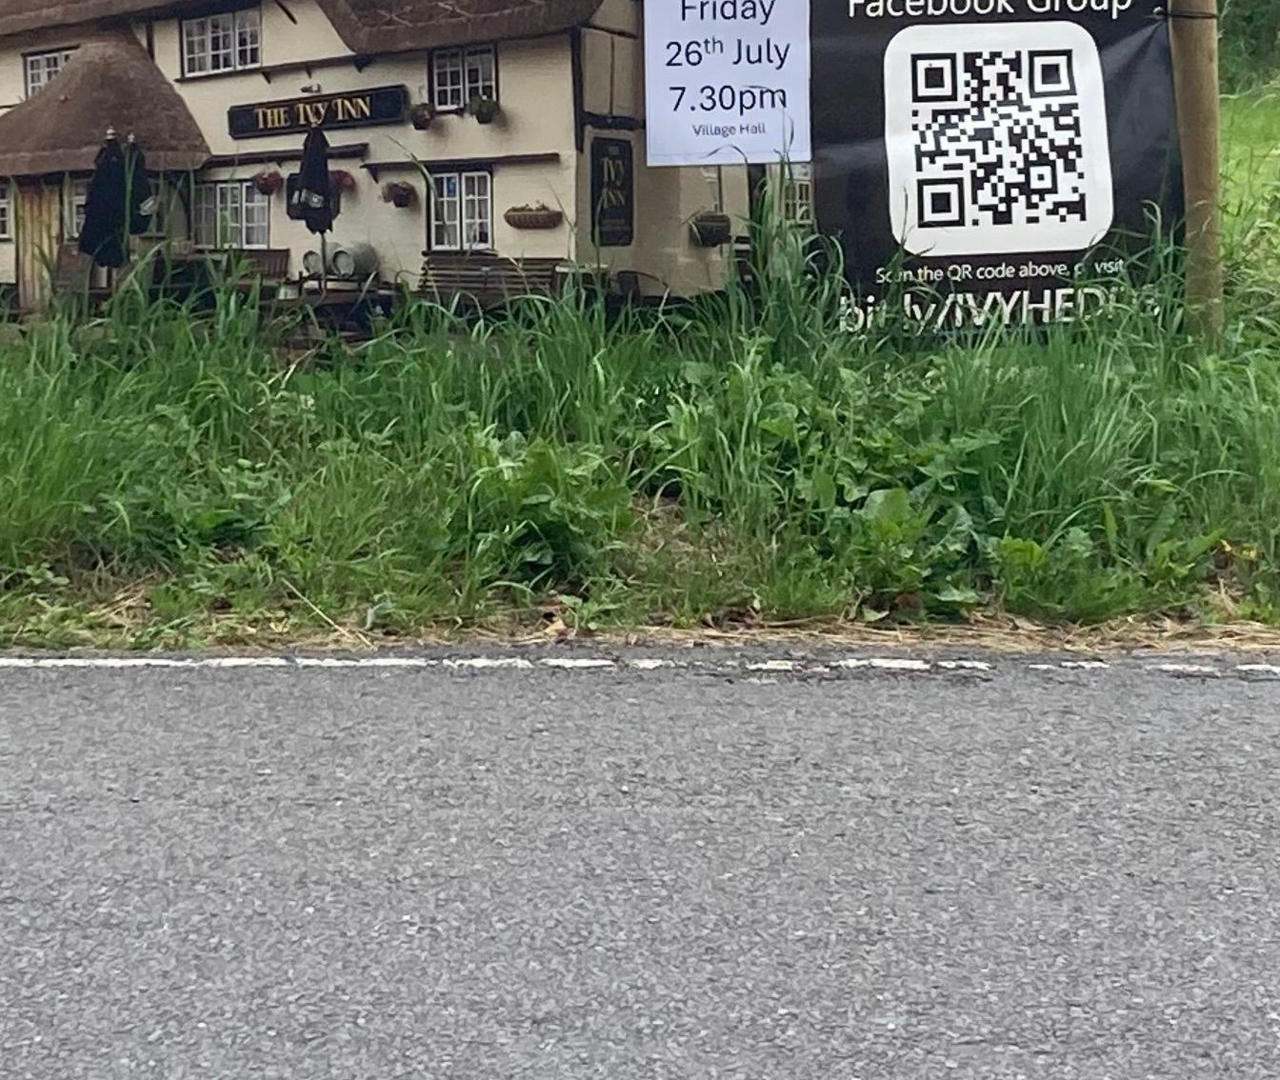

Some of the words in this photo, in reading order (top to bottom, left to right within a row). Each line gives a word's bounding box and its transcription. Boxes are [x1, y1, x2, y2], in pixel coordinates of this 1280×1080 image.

[665, 37, 724, 67] 26th
[733, 37, 791, 70] July
[669, 85, 787, 116] 7.30pm
[254, 107, 290, 129] THE
[692, 123, 737, 138] Village
[740, 122, 766, 135] Hall
[876, 267, 914, 283] Scn
[917, 265, 944, 281] the
[947, 264, 974, 282] QR
[976, 262, 1016, 279] code
[1019, 261, 1071, 278] above,
